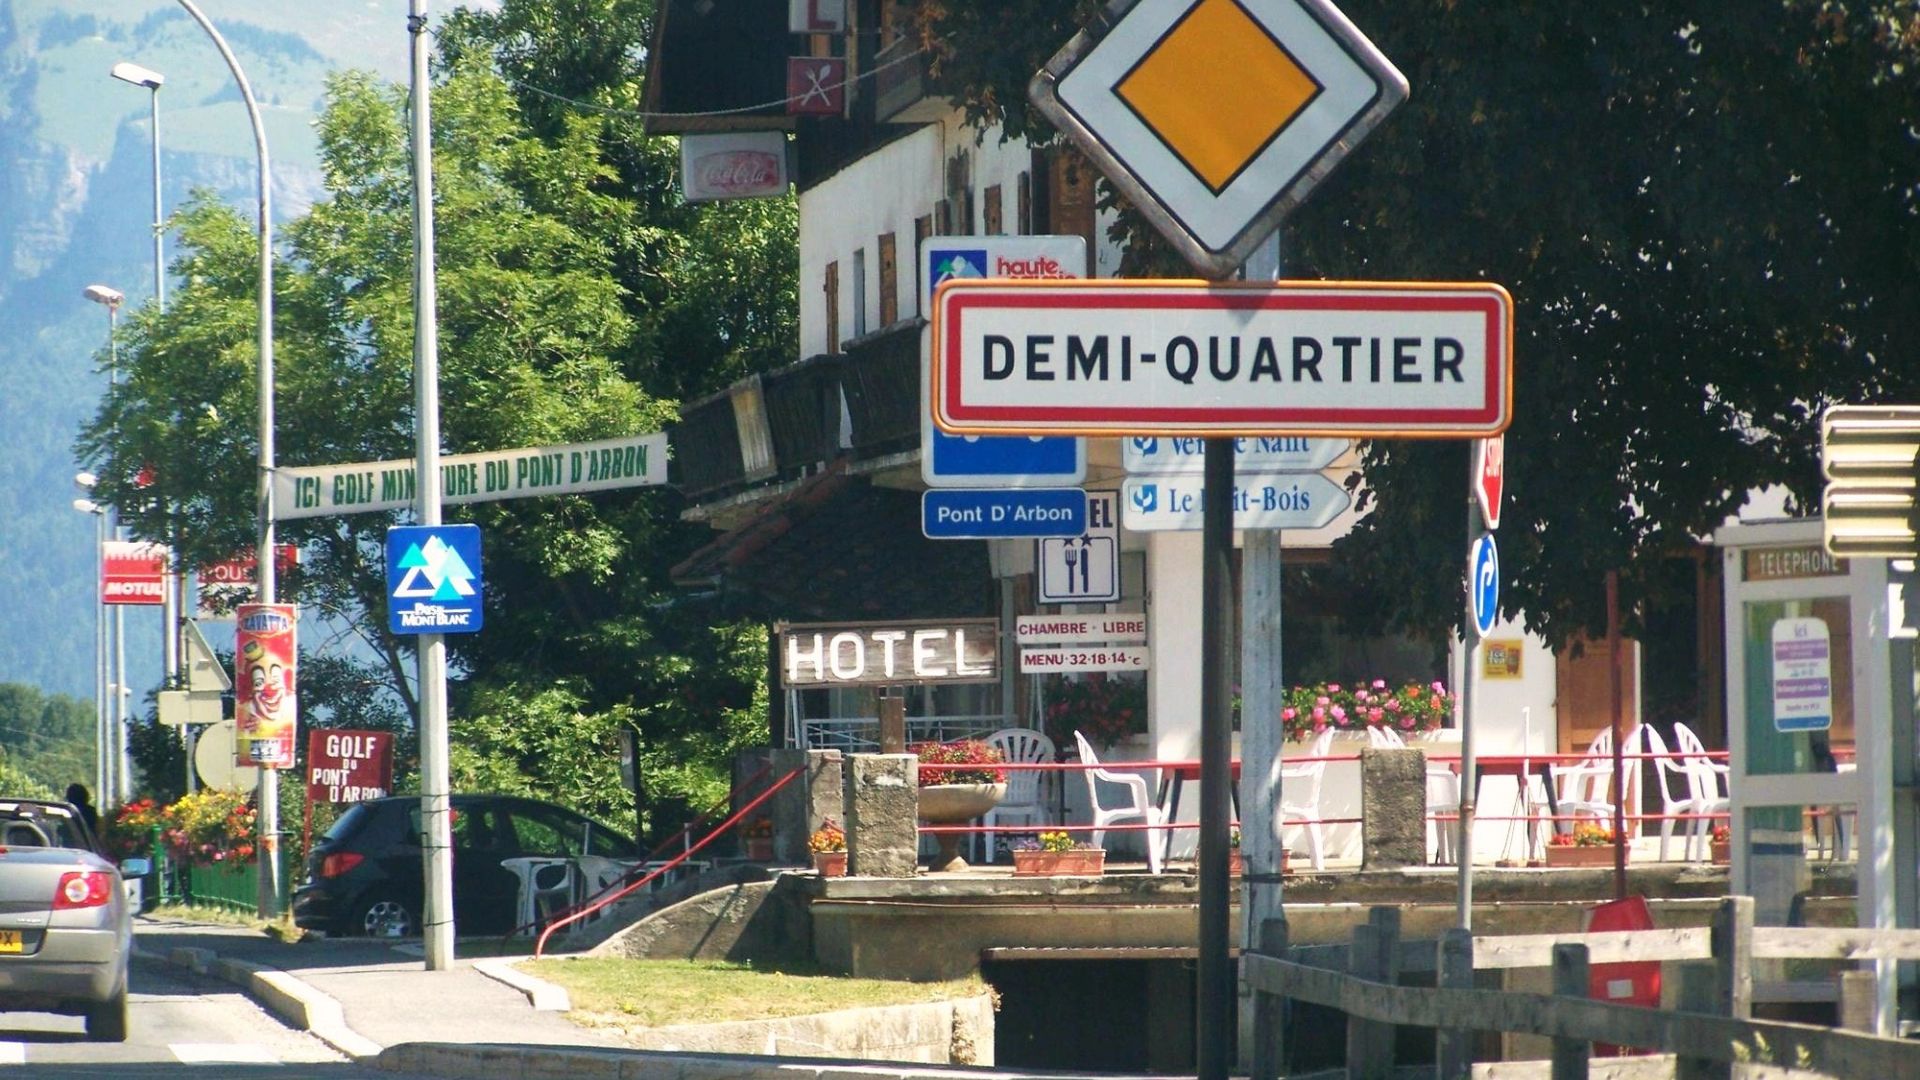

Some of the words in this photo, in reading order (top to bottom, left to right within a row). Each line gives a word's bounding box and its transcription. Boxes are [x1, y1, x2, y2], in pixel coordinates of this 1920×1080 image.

[997, 257, 1058, 275] haute
[983, 335, 1465, 385] DEMI-QUARTIER
[295, 476, 320, 508] ICI
[332, 472, 374, 506] GOLF
[381, 463, 477, 502] MINURE
[485, 459, 509, 493] DU
[517, 453, 564, 489] PONT
[571, 444, 648, 484] D'ARBON
[1169, 488, 1193, 513] Le
[938, 505, 982, 523] Pont
[991, 505, 1073, 523] D'Arbon
[1759, 551, 1840, 576] TELEPHONE
[105, 582, 163, 596] MOTUL
[401, 613, 436, 626] MONT
[436, 612, 470, 626] BLANC
[1018, 622, 1087, 635] CHAMBRE
[1103, 621, 1144, 634] LIBRE
[788, 628, 992, 681] HOTEL
[326, 734, 377, 759] GOLF
[342, 759, 358, 770] DU
[312, 768, 350, 786] PONT
